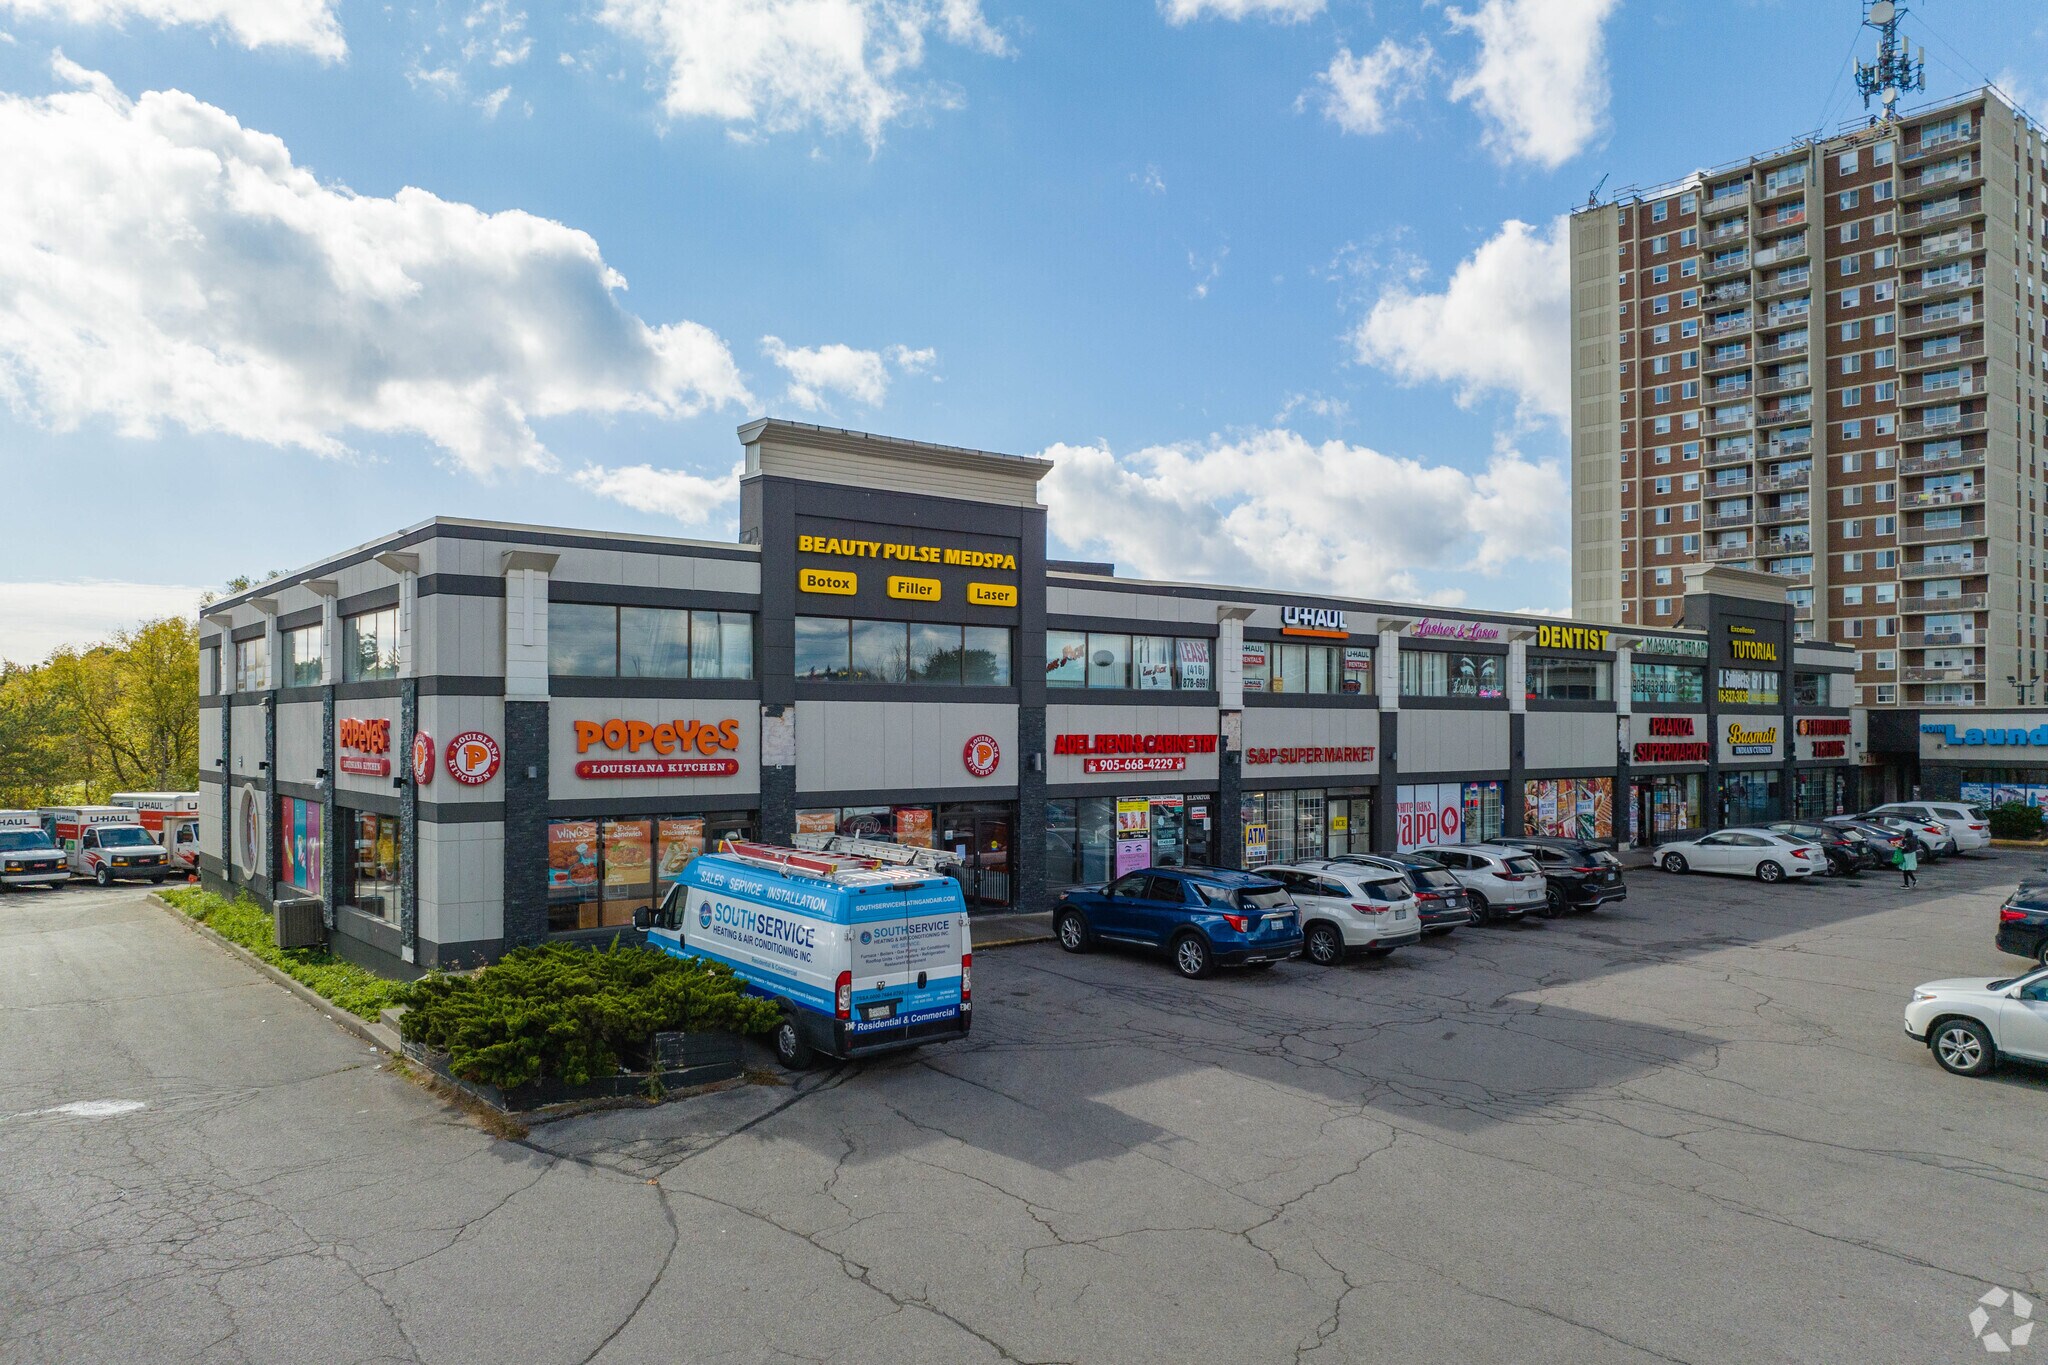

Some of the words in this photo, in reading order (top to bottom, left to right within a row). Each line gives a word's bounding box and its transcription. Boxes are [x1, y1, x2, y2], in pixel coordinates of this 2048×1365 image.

[798, 534, 882, 558] BEAUTY
[882, 543, 941, 563] PULSE
[943, 548, 1017, 570] MEDSPA
[807, 574, 850, 589] Botox
[897, 582, 932, 596] Filler
[976, 588, 1010, 601] Laser
[1282, 606, 1348, 628] U-HAUL
[1414, 617, 1456, 638] Lashes
[1456, 624, 1465, 638] &
[1730, 625, 1756, 634] Excellence
[1539, 625, 1610, 650] DENTIST
[1646, 638, 1679, 654] MASSAGE
[1180, 642, 1208, 662] LEASE
[1243, 644, 1264, 653] -HAUL
[1347, 650, 1369, 658] U-HAUL
[1732, 640, 1776, 660] TUTORIAL
[1187, 664, 1204, 676] (416)
[1650, 718, 1695, 736] PAAKIZA
[1728, 723, 1776, 744] Basmati
[1921, 724, 1945, 733] COIN
[1945, 724, 2048, 746] Laund
[453, 733, 498, 762] LOUISIANA
[970, 736, 999, 758] LOUISIANA
[1054, 734, 1095, 755] ADEL
[1133, 734, 1143, 753] &
[1143, 734, 1218, 753] CABINETRY
[1636, 743, 1710, 762] SUPERMARKET
[464, 744, 488, 771] P
[977, 744, 993, 766] P
[1100, 759, 1173, 770] 905-668-4229
[1247, 748, 1278, 764] S&P
[448, 760, 490, 784] KITCHEN
[592, 764, 664, 774] LOUISIANA
[668, 763, 726, 772] KITCHEN
[967, 756, 994, 775] KITCHEN
[138, 802, 163, 810] U-HAUL
[56, 814, 76, 823] U-HAUL
[852, 821, 878, 833] OPEN
[1248, 828, 1265, 844] ATM
[700, 871, 724, 887] SALES
[728, 878, 763, 896] SERVICE
[767, 886, 827, 912] INSTALLATION
[856, 896, 956, 912] SOUTHSERVICEHEATINGANDAIR.COM
[713, 925, 737, 940] HEATING
[738, 933, 742, 942] &
[743, 934, 754, 946] AIR
[754, 937, 799, 959] CONDITIONING
[799, 951, 813, 964] INC.
[858, 1017, 901, 1031] Residential
[911, 1008, 955, 1023] Commercial
